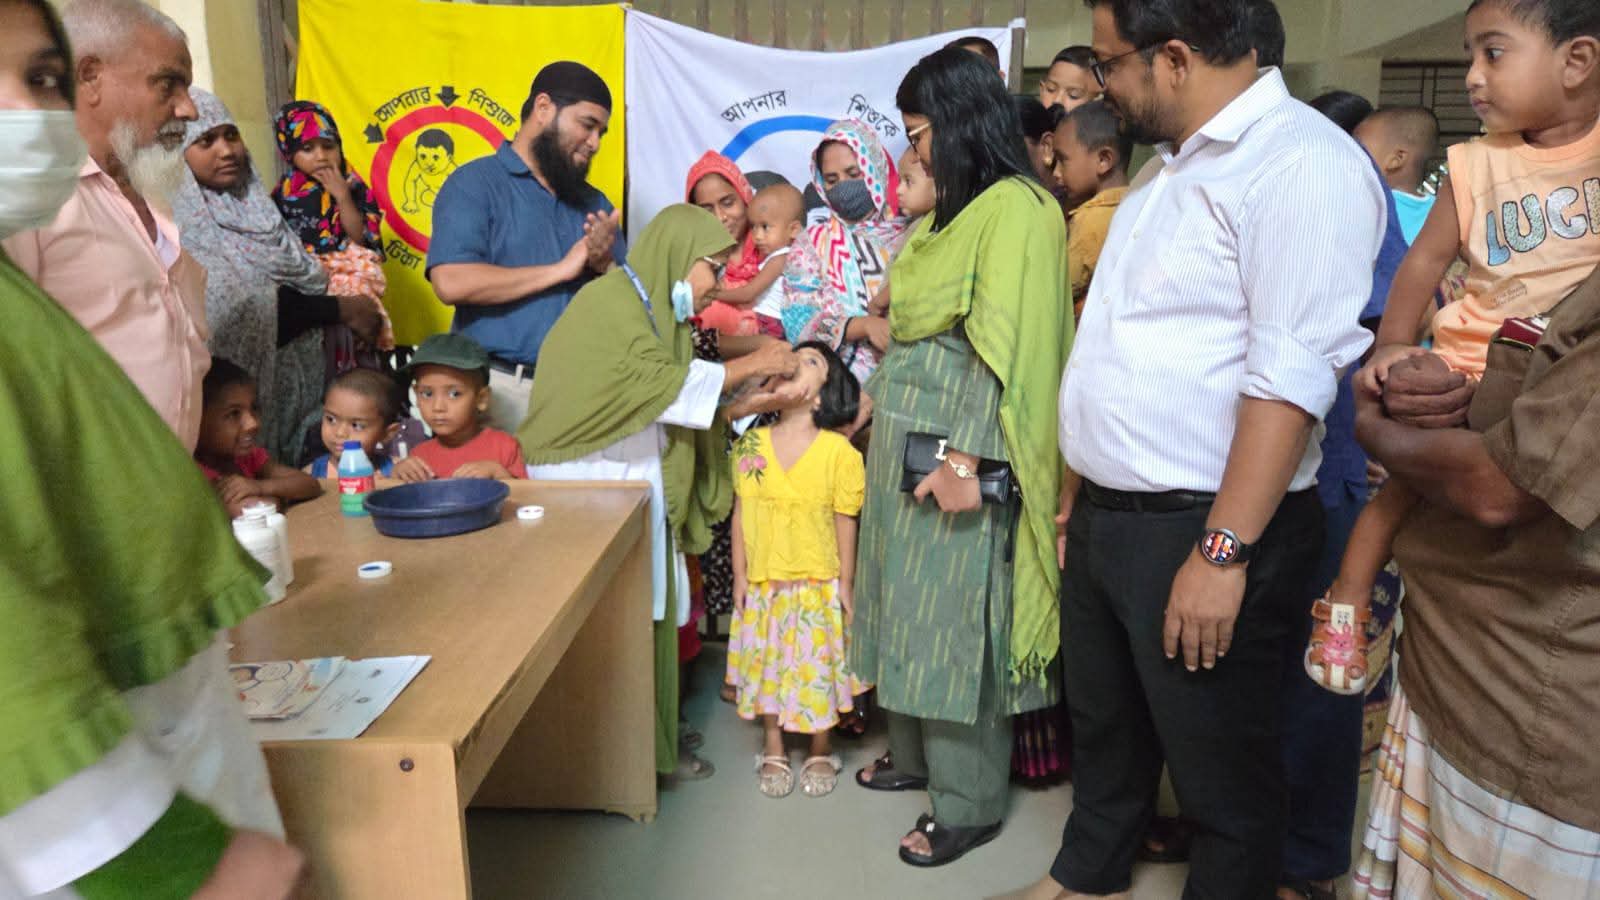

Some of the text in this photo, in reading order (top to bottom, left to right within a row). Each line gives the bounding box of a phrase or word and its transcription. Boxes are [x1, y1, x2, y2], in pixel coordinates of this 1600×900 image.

[374, 86, 516, 127] আপনার শিশুকে
[721, 90, 900, 137] আপনার শিশুকে
[386, 239, 422, 270] টিকা
